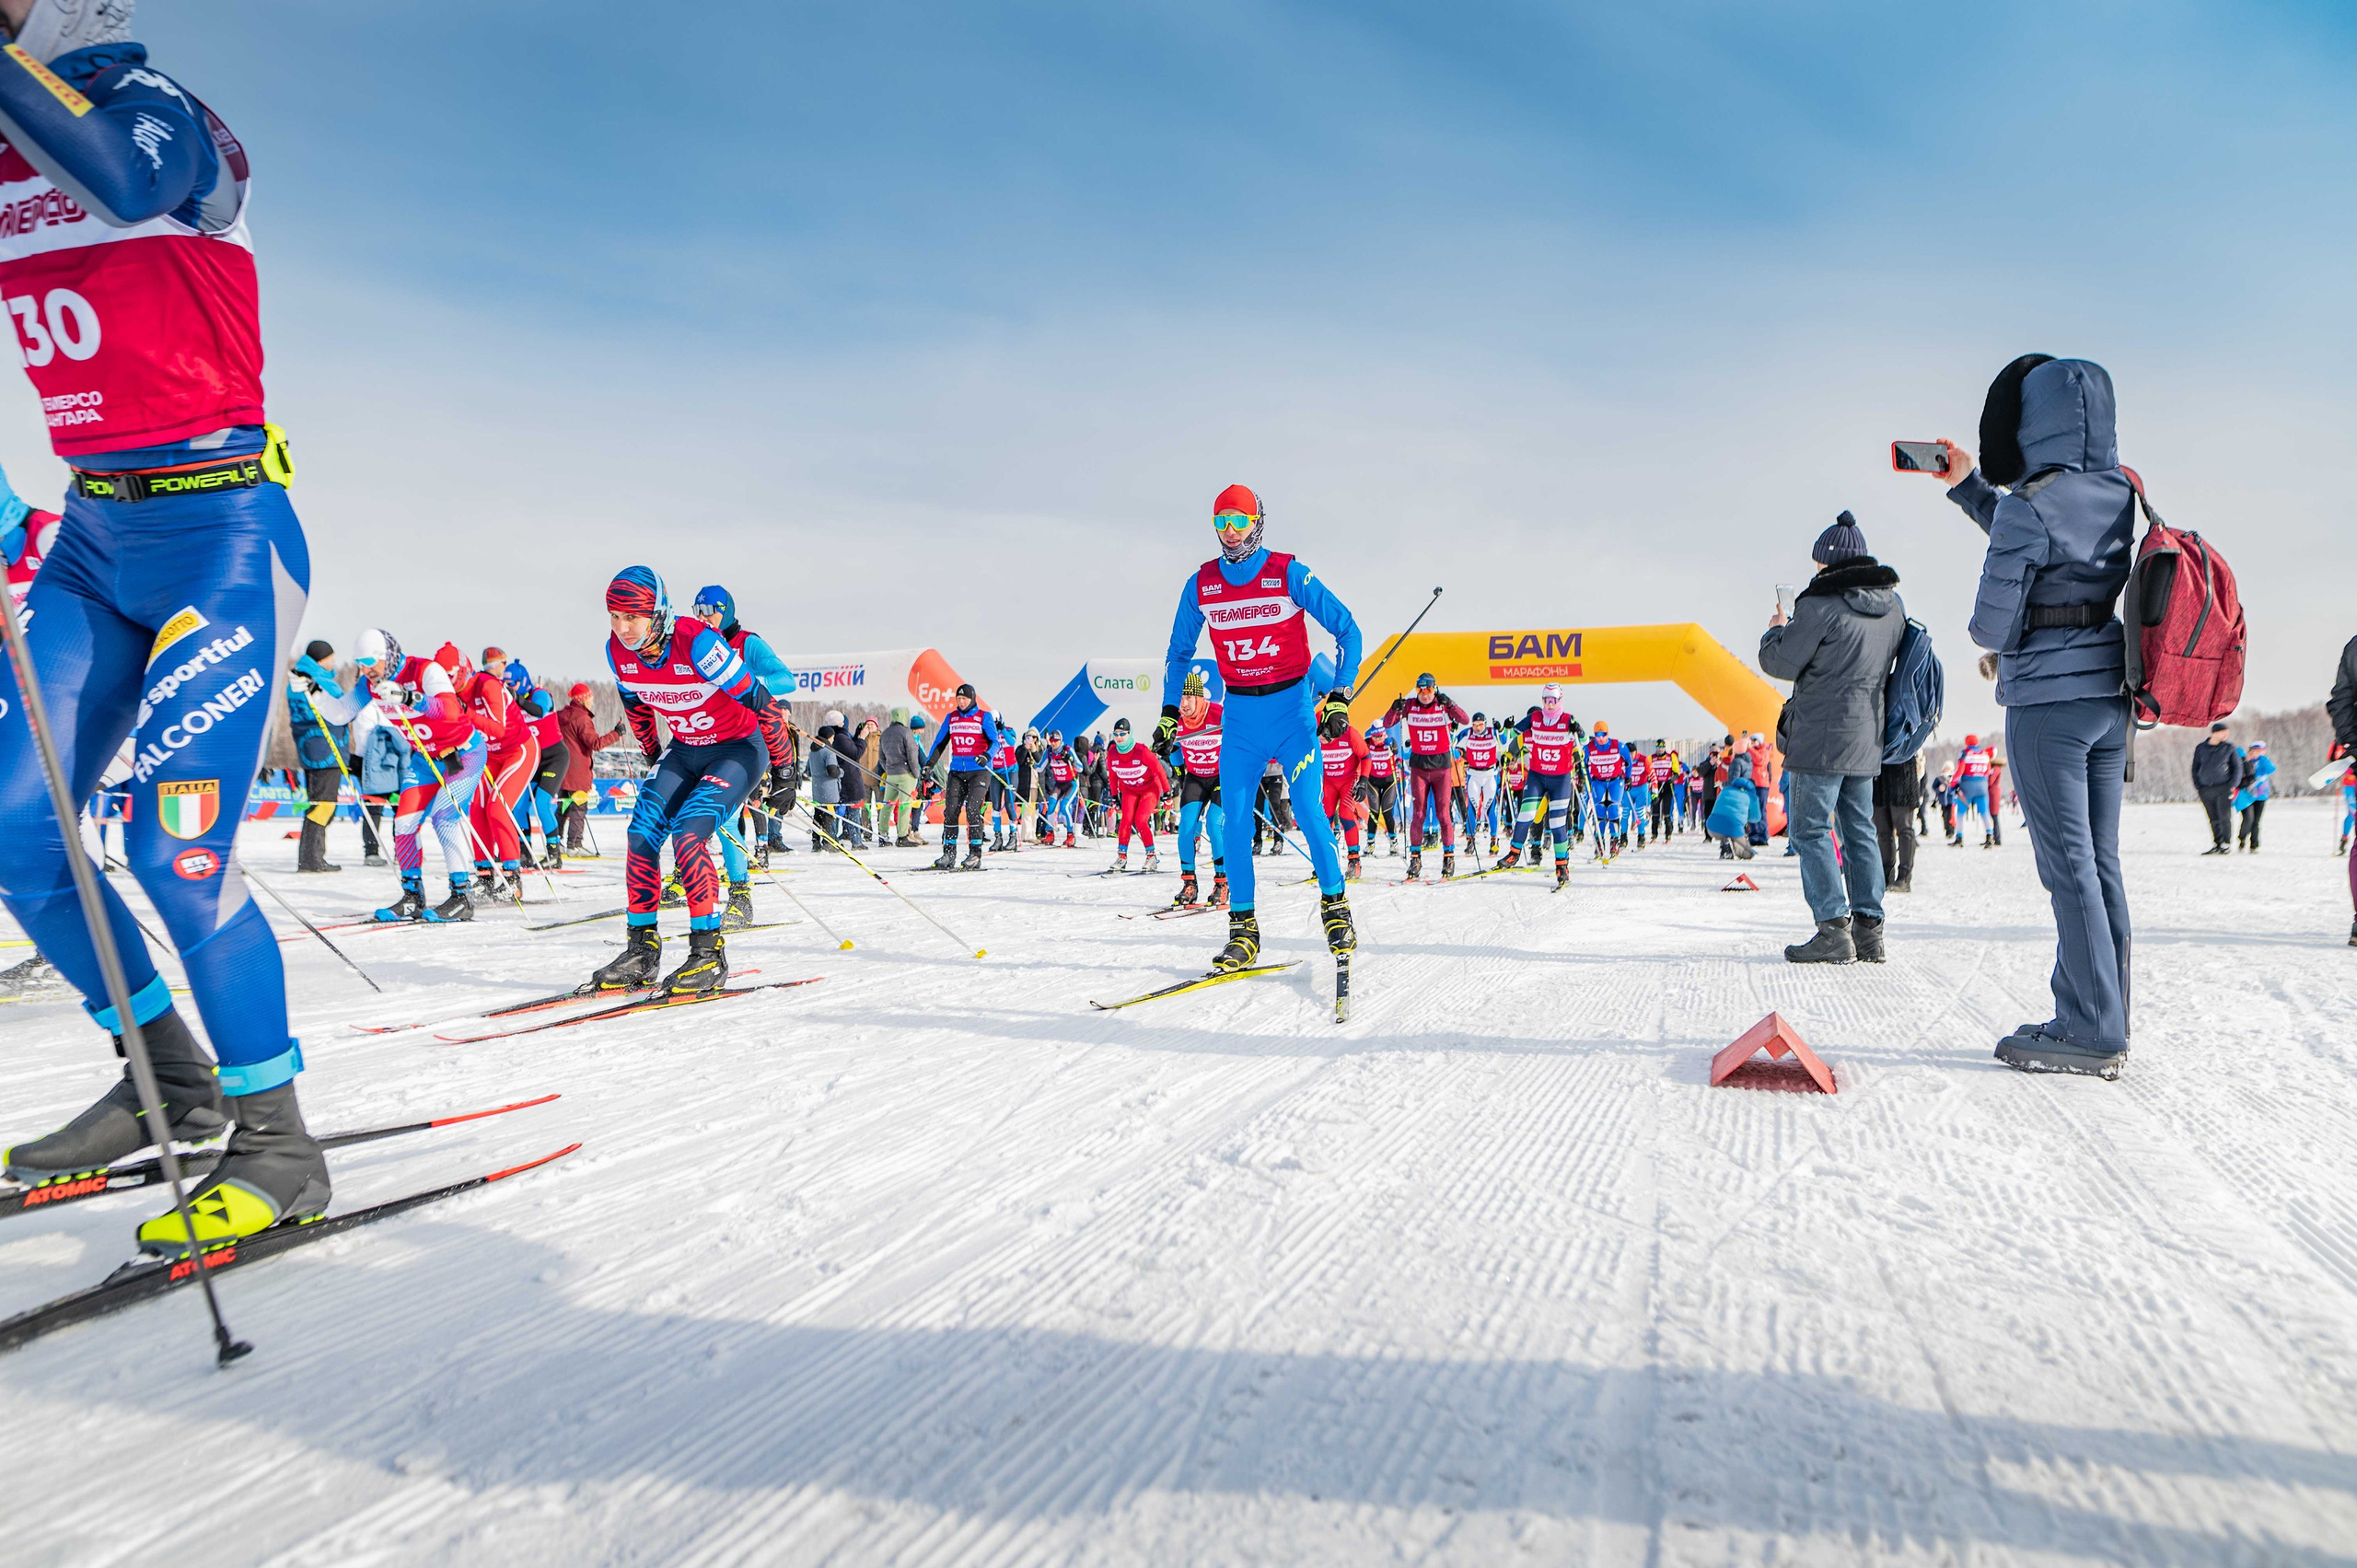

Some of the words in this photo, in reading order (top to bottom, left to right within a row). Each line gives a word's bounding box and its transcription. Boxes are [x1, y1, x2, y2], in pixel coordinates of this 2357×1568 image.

[1202, 584, 1222, 592] БАМ
[1210, 603, 1282, 623] ТЕМЕРСО
[1224, 636, 1281, 662] 134
[1489, 633, 1582, 659] БАМ
[147, 626, 255, 704] sportful
[1504, 667, 1569, 678] МАРАФОНЫ
[1094, 676, 1133, 689] Слата
[134, 668, 265, 784] FALCONERI
[664, 711, 716, 734] 26
[954, 737, 975, 746] 110
[1417, 730, 1438, 742] 151
[1186, 750, 1219, 764] 223
[1472, 751, 1490, 761] 156
[1538, 747, 1561, 762] 163
[1373, 761, 1388, 770] 119
[1596, 765, 1615, 773] 155
[166, 782, 215, 795] ITALIA
[250, 784, 292, 800] Слата
[24, 1177, 108, 1207] ATOMIC
